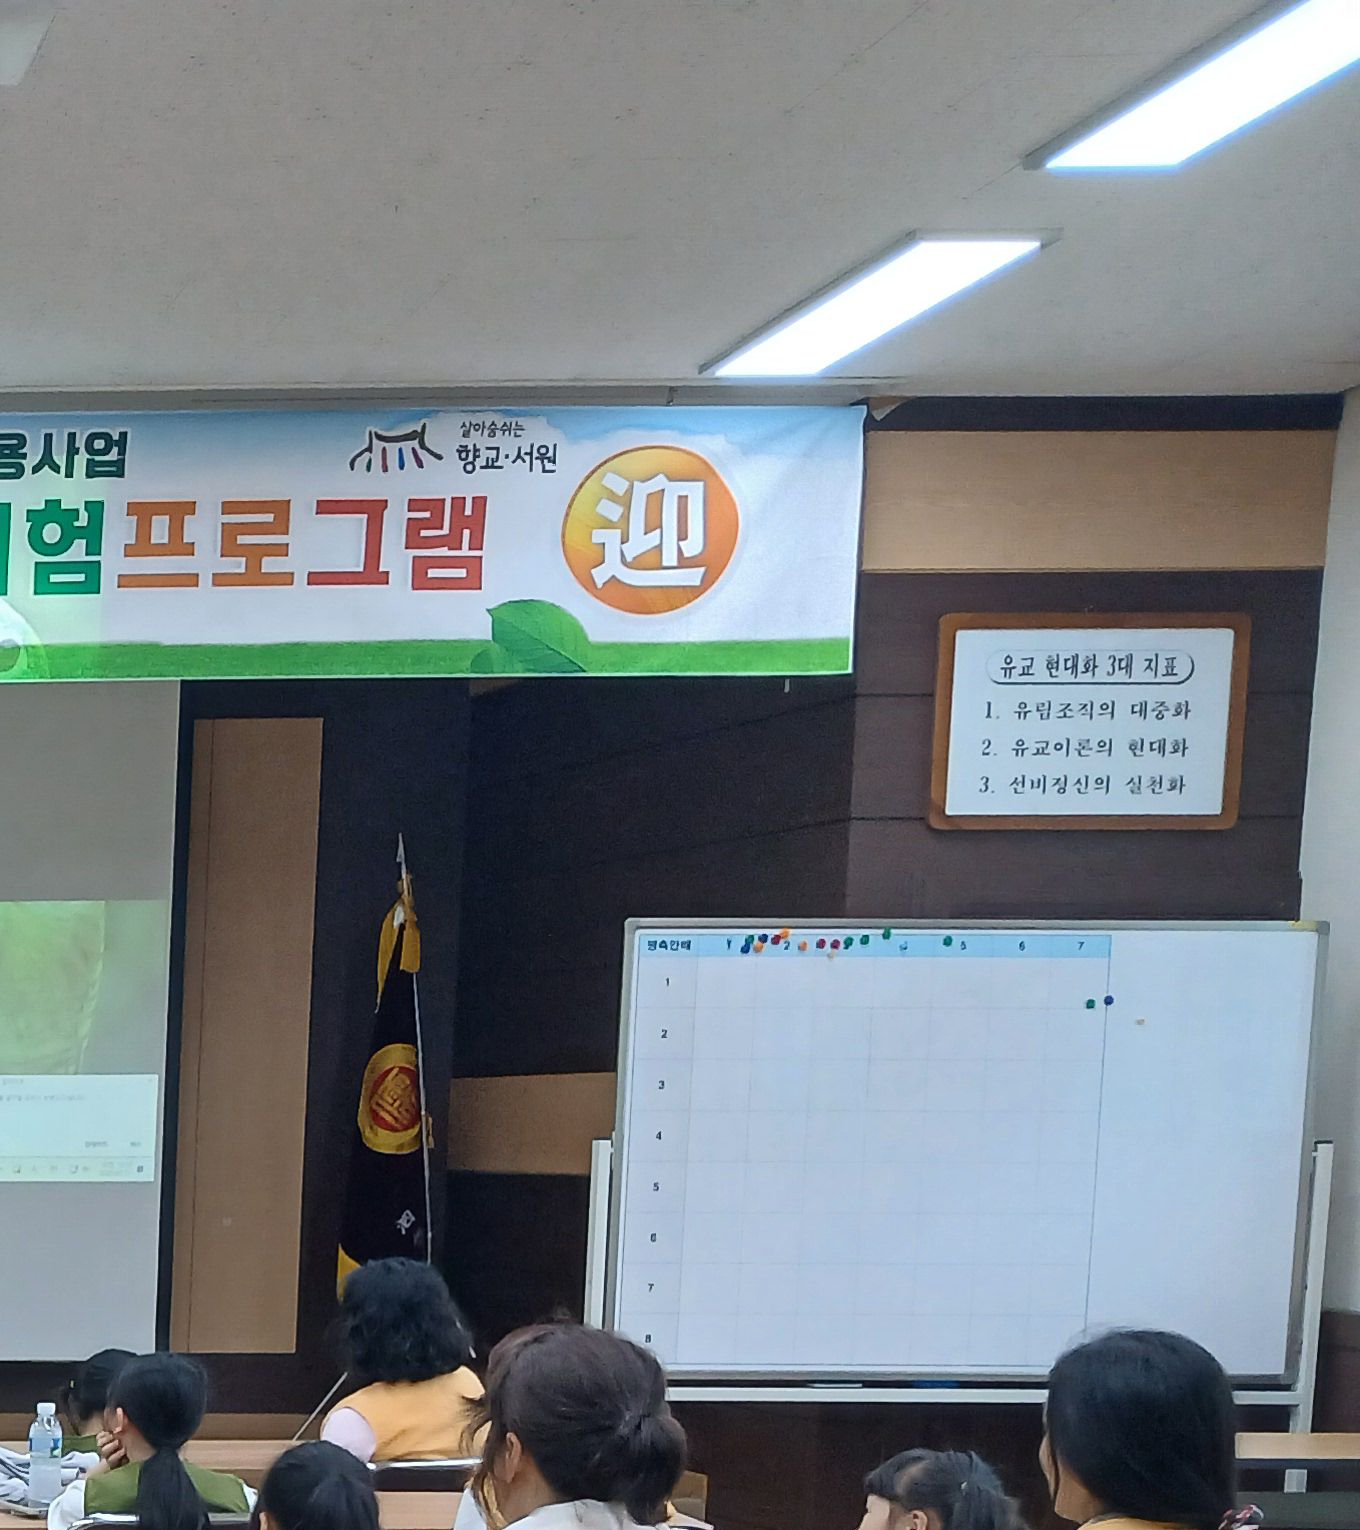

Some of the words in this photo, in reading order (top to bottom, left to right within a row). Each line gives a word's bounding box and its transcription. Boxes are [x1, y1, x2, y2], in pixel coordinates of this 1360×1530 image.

[456, 442, 558, 474] 향교·서원
[592, 471, 708, 589] 迎
[999, 654, 1035, 679] 유교
[1045, 653, 1099, 679] 현대화
[1106, 653, 1134, 679] 3대
[1143, 653, 1179, 679] 지표
[984, 701, 1001, 719] 1.
[1013, 700, 1116, 721] 유림조직의
[1130, 700, 1192, 721] 대중화
[981, 738, 998, 757] 2.
[1011, 737, 1113, 758] 유교이론의
[978, 775, 995, 794] 3.
[1008, 774, 1111, 795] 선비정신의
[1125, 774, 1186, 795] 실천화
[661, 1028, 668, 1038] 2
[658, 1080, 665, 1090] 3
[655, 1130, 662, 1140] 4
[652, 1182, 660, 1192] 5
[647, 1283, 655, 1292] 7
